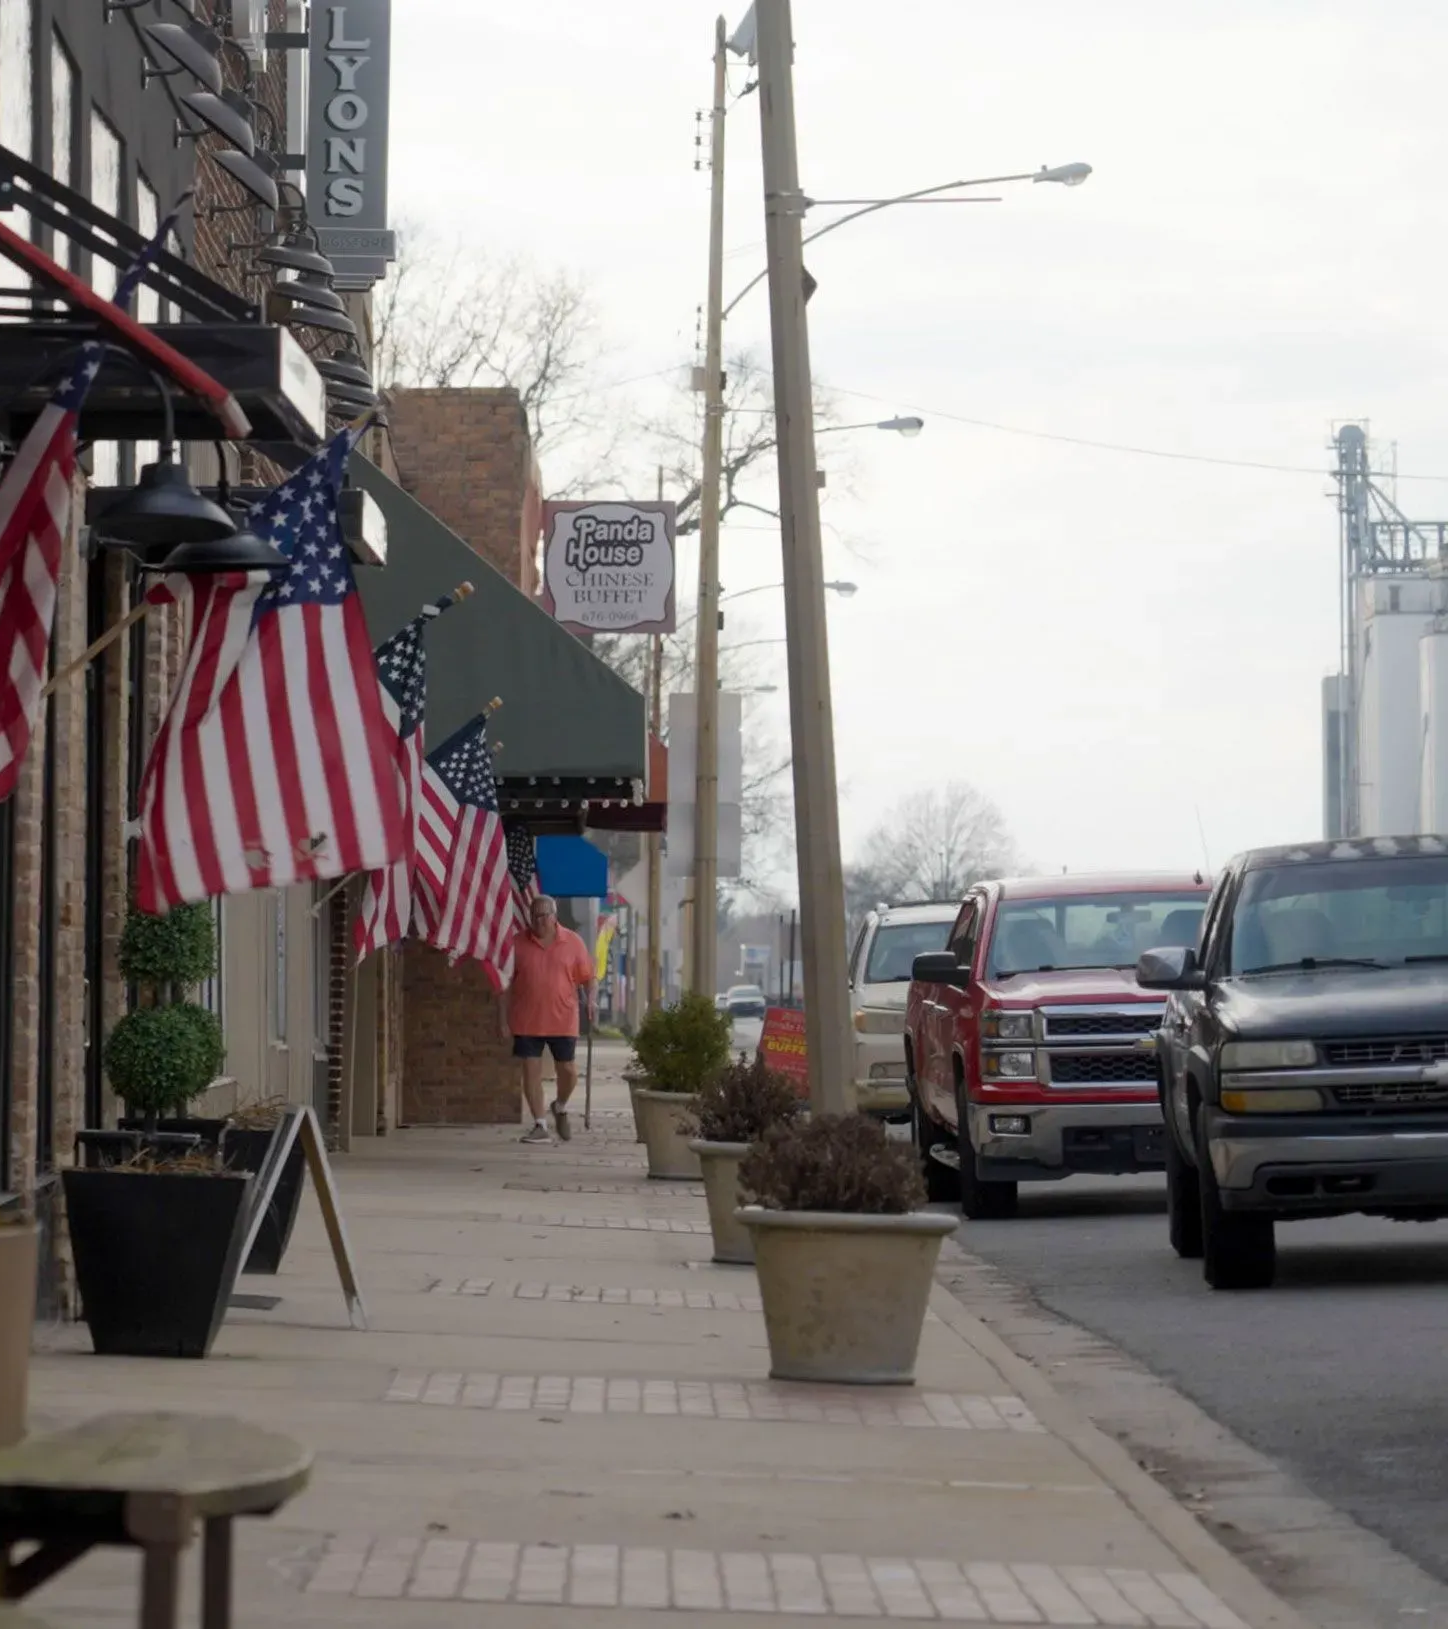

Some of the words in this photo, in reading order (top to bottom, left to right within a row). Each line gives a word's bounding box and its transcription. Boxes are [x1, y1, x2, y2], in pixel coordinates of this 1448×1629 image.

[325, 6, 371, 217] LYONS
[573, 515, 654, 546] Panda
[566, 538, 643, 571] House
[565, 573, 654, 587] CHINESE
[574, 590, 647, 604] BUFFET
[767, 1041, 808, 1055] BUFFE
